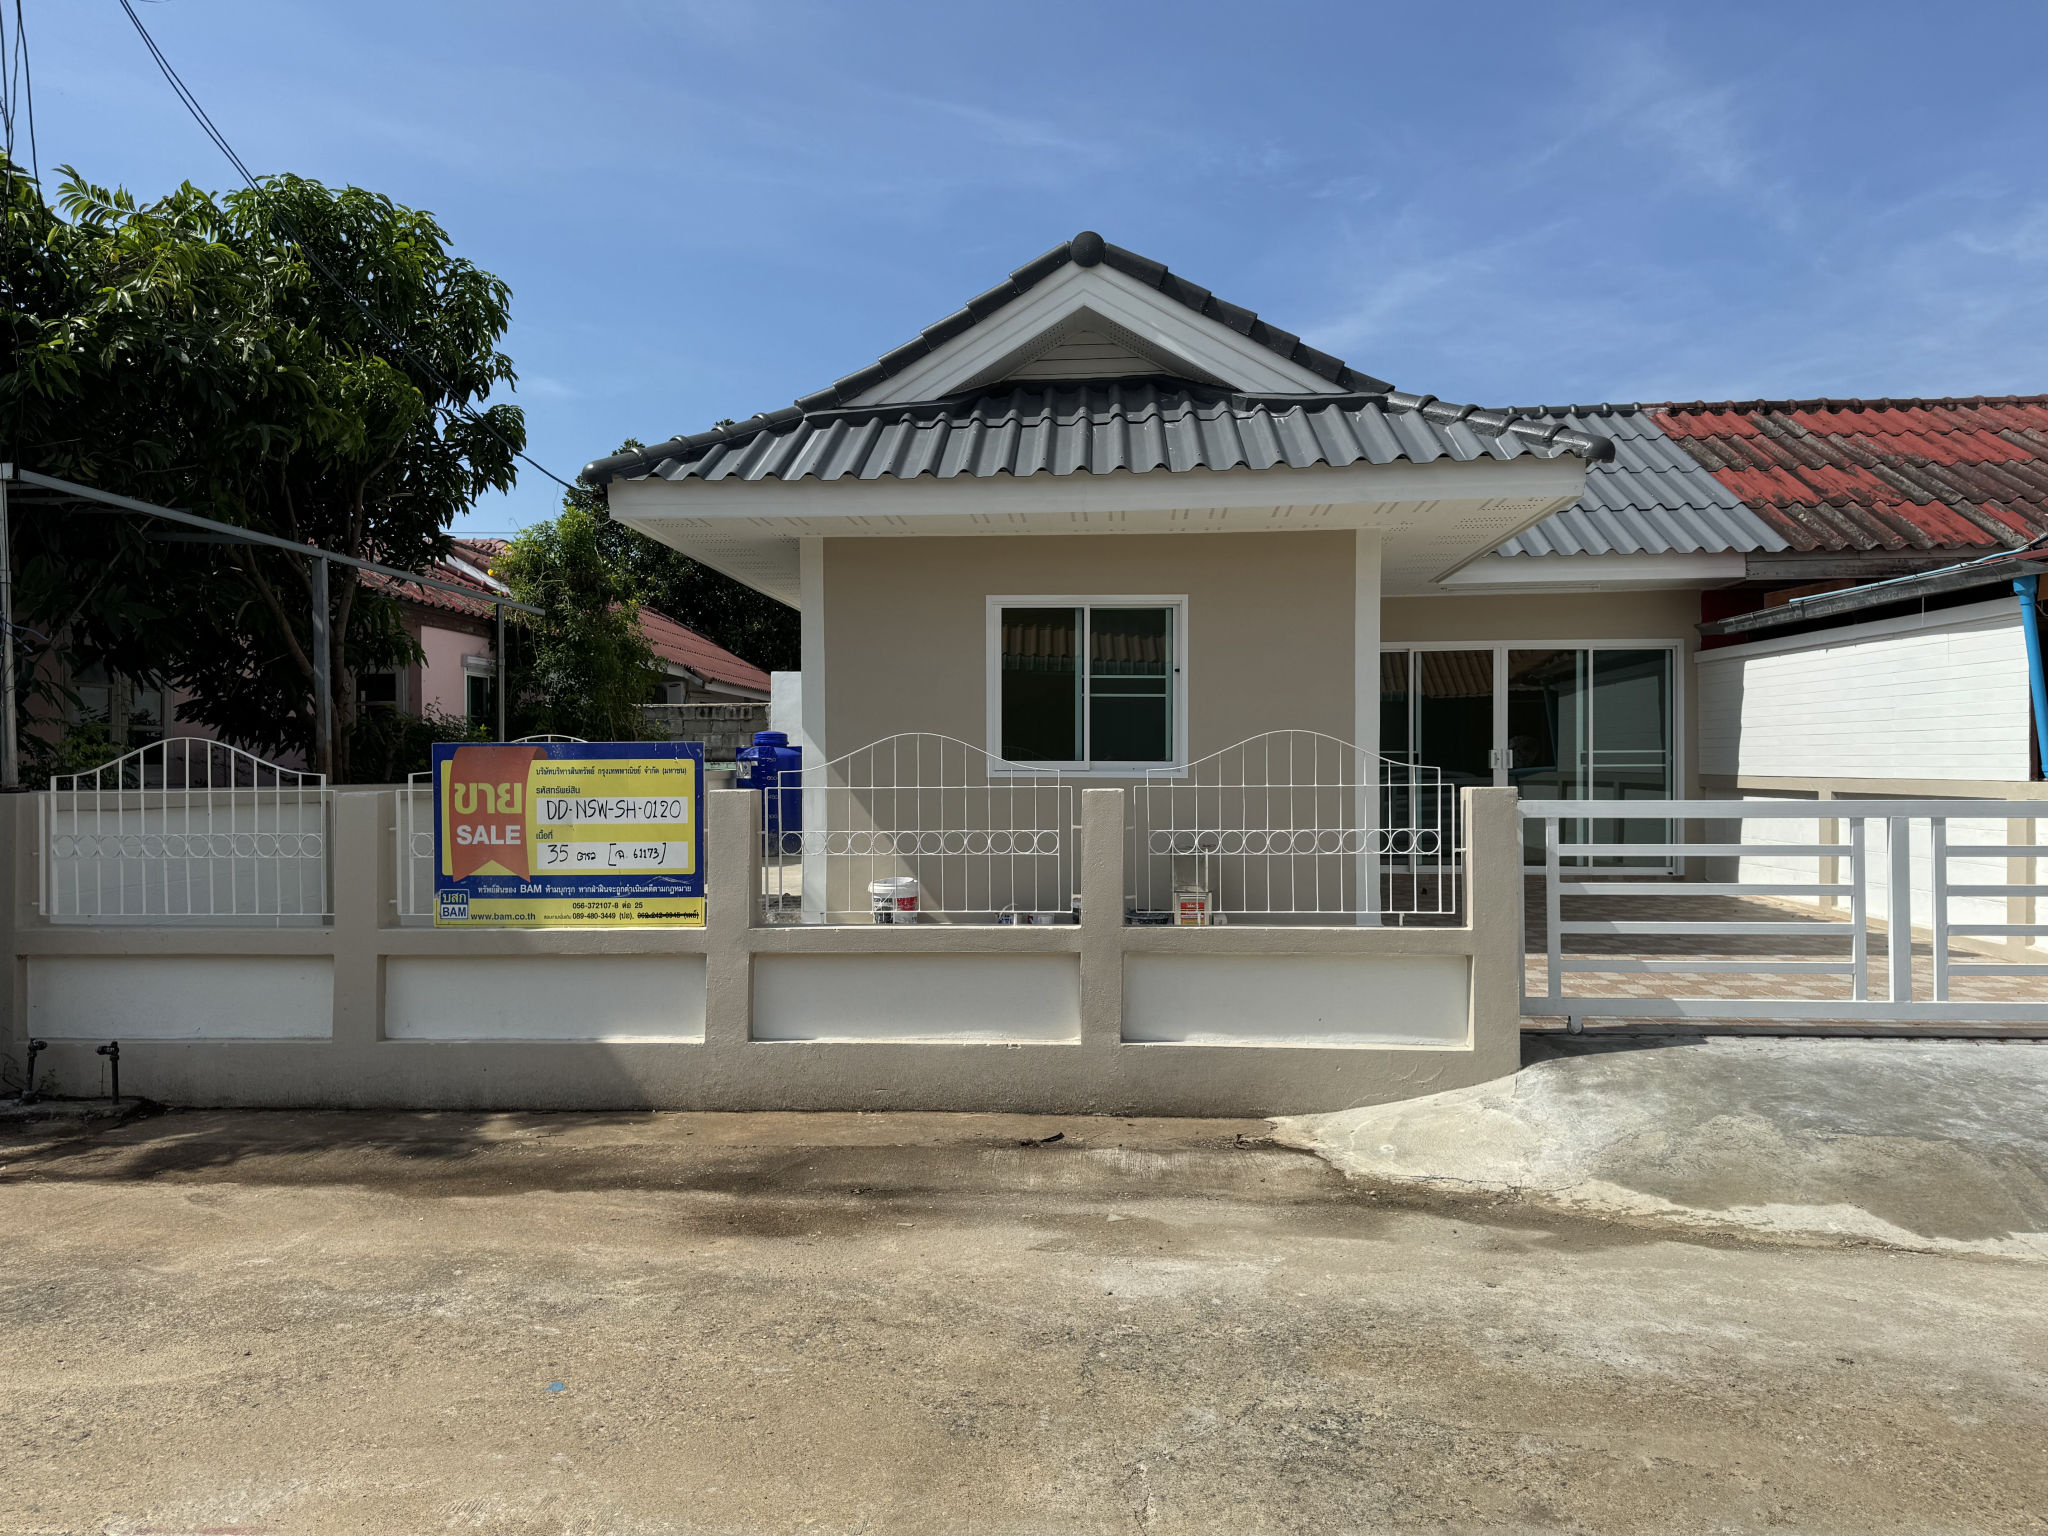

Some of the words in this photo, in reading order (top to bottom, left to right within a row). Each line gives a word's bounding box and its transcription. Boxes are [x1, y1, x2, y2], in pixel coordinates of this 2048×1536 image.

[644, 766, 660, 775] จำกัด
[662, 767, 687, 776] (มหาชน)
[536, 785, 581, 794] รหัสทรัพย์สิน
[454, 783, 523, 814] ขาย
[456, 825, 522, 845] SALE
[535, 829, 554, 840] เนื้อที่
[547, 844, 569, 864] 35
[477, 884, 517, 894] ทรัพย์สินของ
[520, 884, 542, 893] BAM
[545, 884, 576, 896] ห้ามบุกรุก
[442, 893, 467, 903] บสก
[622, 901, 631, 909] ต่อ
[442, 906, 467, 917] BAM
[471, 912, 536, 920] www.bam.co.th
